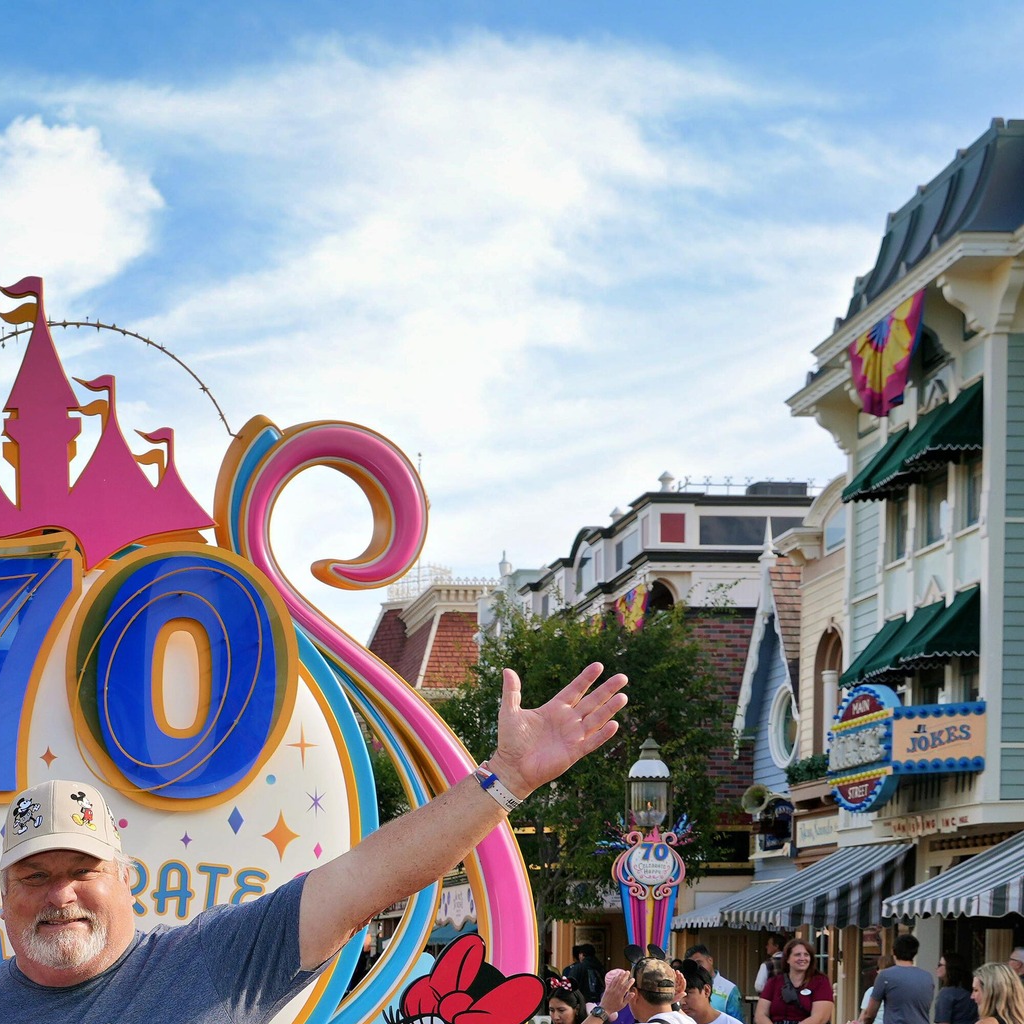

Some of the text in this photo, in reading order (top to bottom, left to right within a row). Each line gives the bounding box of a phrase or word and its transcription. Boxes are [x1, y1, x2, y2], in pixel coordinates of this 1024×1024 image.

[851, 699, 871, 716] MAIN
[907, 724, 971, 753] JOKES
[847, 784, 869, 800] STREET
[640, 843, 669, 861] 70
